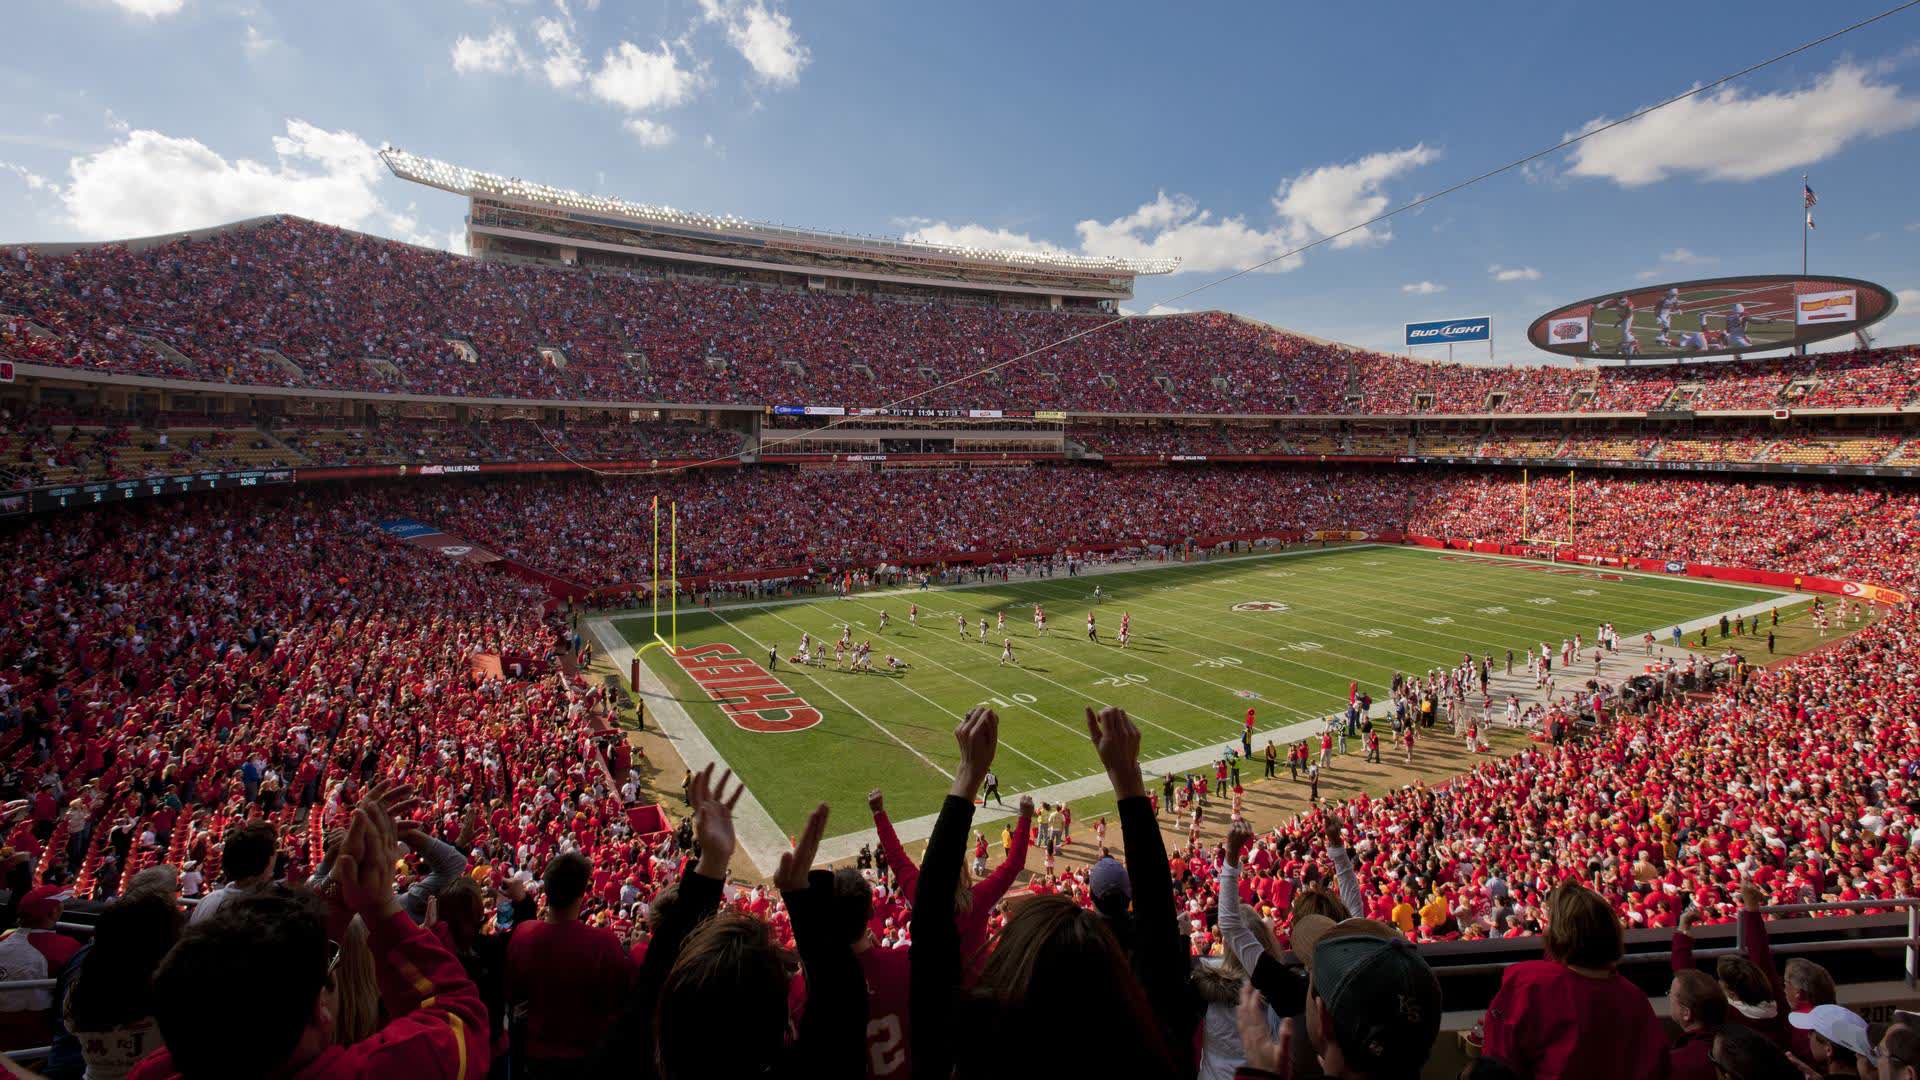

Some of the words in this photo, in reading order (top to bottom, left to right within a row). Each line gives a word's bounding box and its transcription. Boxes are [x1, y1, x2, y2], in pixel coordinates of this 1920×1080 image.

[1410, 329, 1439, 338] BUD
[1444, 325, 1486, 335] LIGHT
[444, 465, 463, 473] VALUE
[1666, 462, 1691, 470] 11:04
[1199, 656, 1243, 669] 30
[1101, 673, 1149, 688] 20
[661, 643, 824, 733] CHIEFS
[991, 693, 1038, 709] 10
[865, 1013, 905, 1077] 2
